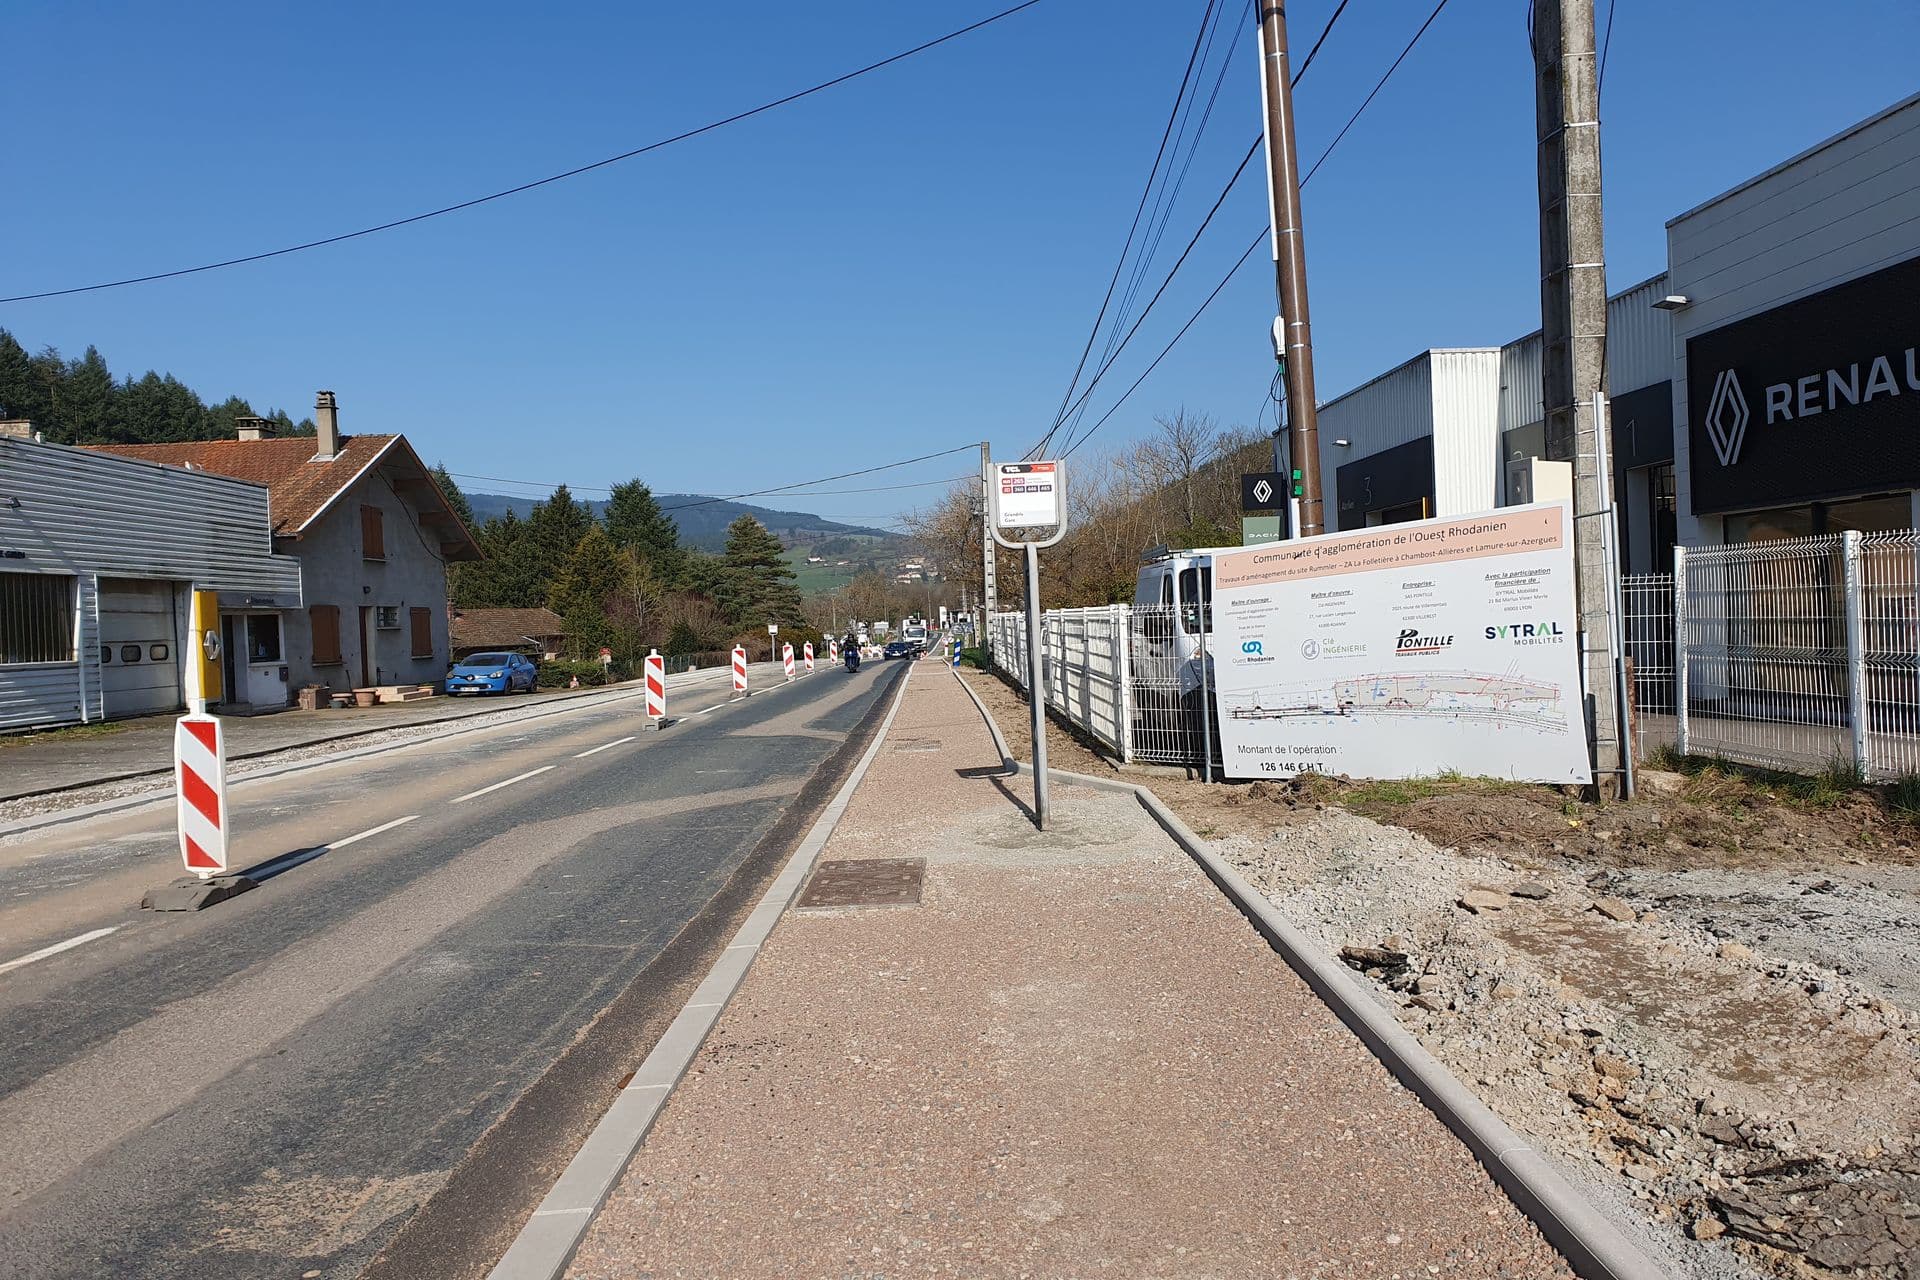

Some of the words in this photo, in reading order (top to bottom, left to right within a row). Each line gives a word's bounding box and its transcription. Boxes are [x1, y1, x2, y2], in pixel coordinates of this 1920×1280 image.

[1363, 476, 1372, 506] 3
[1253, 549, 1312, 565] Communauté
[1314, 537, 1391, 557] d'agglomération
[1393, 534, 1407, 545] de
[1409, 530, 1445, 543] l'Ouest
[1448, 521, 1507, 538] Rhodanien
[1219, 575, 1241, 584] Travaux
[1241, 569, 1287, 582] d'aménagement
[1287, 566, 1296, 576] du
[1298, 565, 1308, 575] site
[1362, 555, 1395, 567] Folletière
[1400, 545, 1465, 561] Chambost-Allières
[1465, 545, 1474, 553] et
[1475, 536, 1558, 553] Lamure-sur-Azergues
[1485, 573, 1501, 581] Avec
[1509, 568, 1551, 579] participation
[1402, 581, 1433, 590] Entreprise
[1494, 578, 1527, 588] financière
[1396, 628, 1454, 649] PONTILLE
[1484, 621, 1563, 640] SYTRAL
[1238, 745, 1273, 754] Montant
[1275, 745, 1286, 754] de
[1288, 744, 1337, 756] l'opération
[1260, 762, 1277, 772] 126
[1279, 762, 1296, 772] 146
